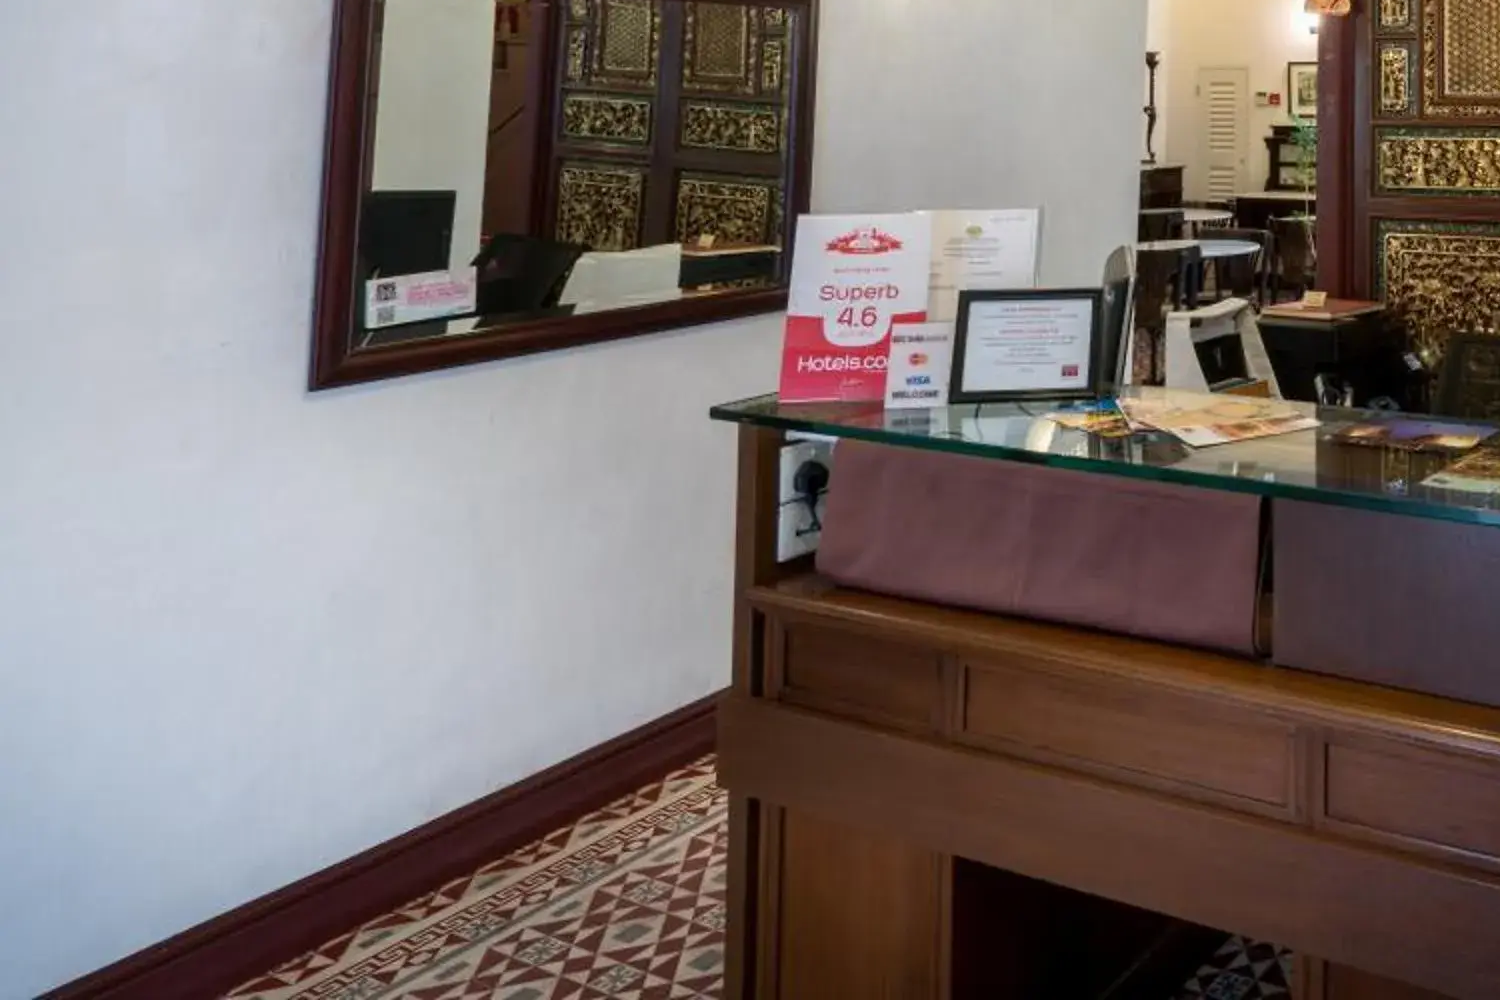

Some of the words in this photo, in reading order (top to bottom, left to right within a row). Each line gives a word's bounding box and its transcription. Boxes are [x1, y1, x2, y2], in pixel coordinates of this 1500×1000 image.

[819, 282, 899, 305] Superb
[837, 305, 878, 328] 4.6
[797, 354, 888, 373] Hotels.co
[906, 375, 931, 386] VISA
